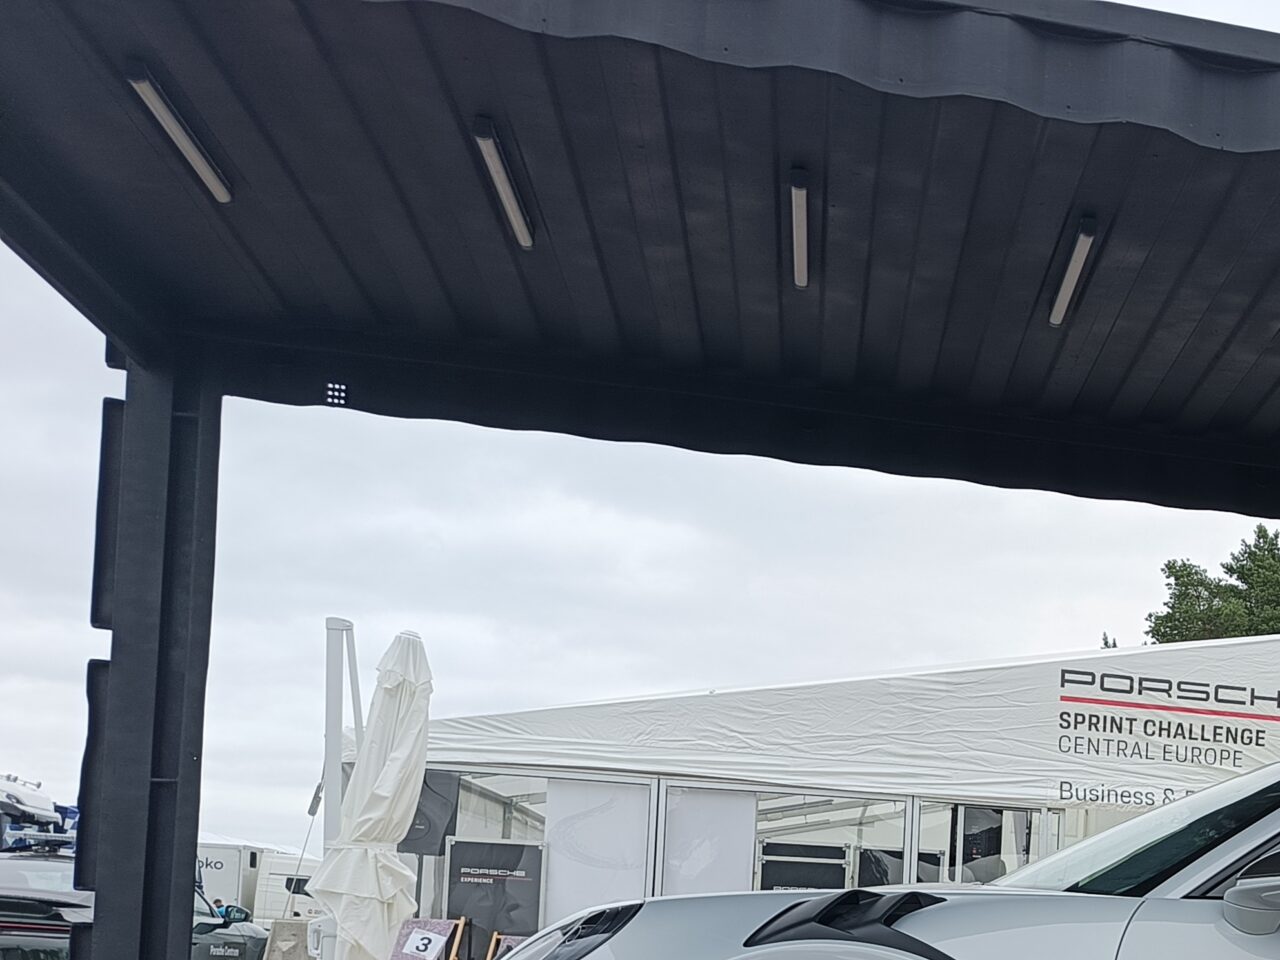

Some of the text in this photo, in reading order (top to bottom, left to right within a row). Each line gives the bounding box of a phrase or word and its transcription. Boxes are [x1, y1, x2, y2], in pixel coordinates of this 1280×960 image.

[1059, 711, 1266, 747] SPRINT CHALLENGE
[1058, 734, 1243, 768] CENTRAL EUROPE
[1059, 781, 1155, 806] Business
[460, 867, 526, 877] PORSCHE
[415, 936, 433, 953] 3
